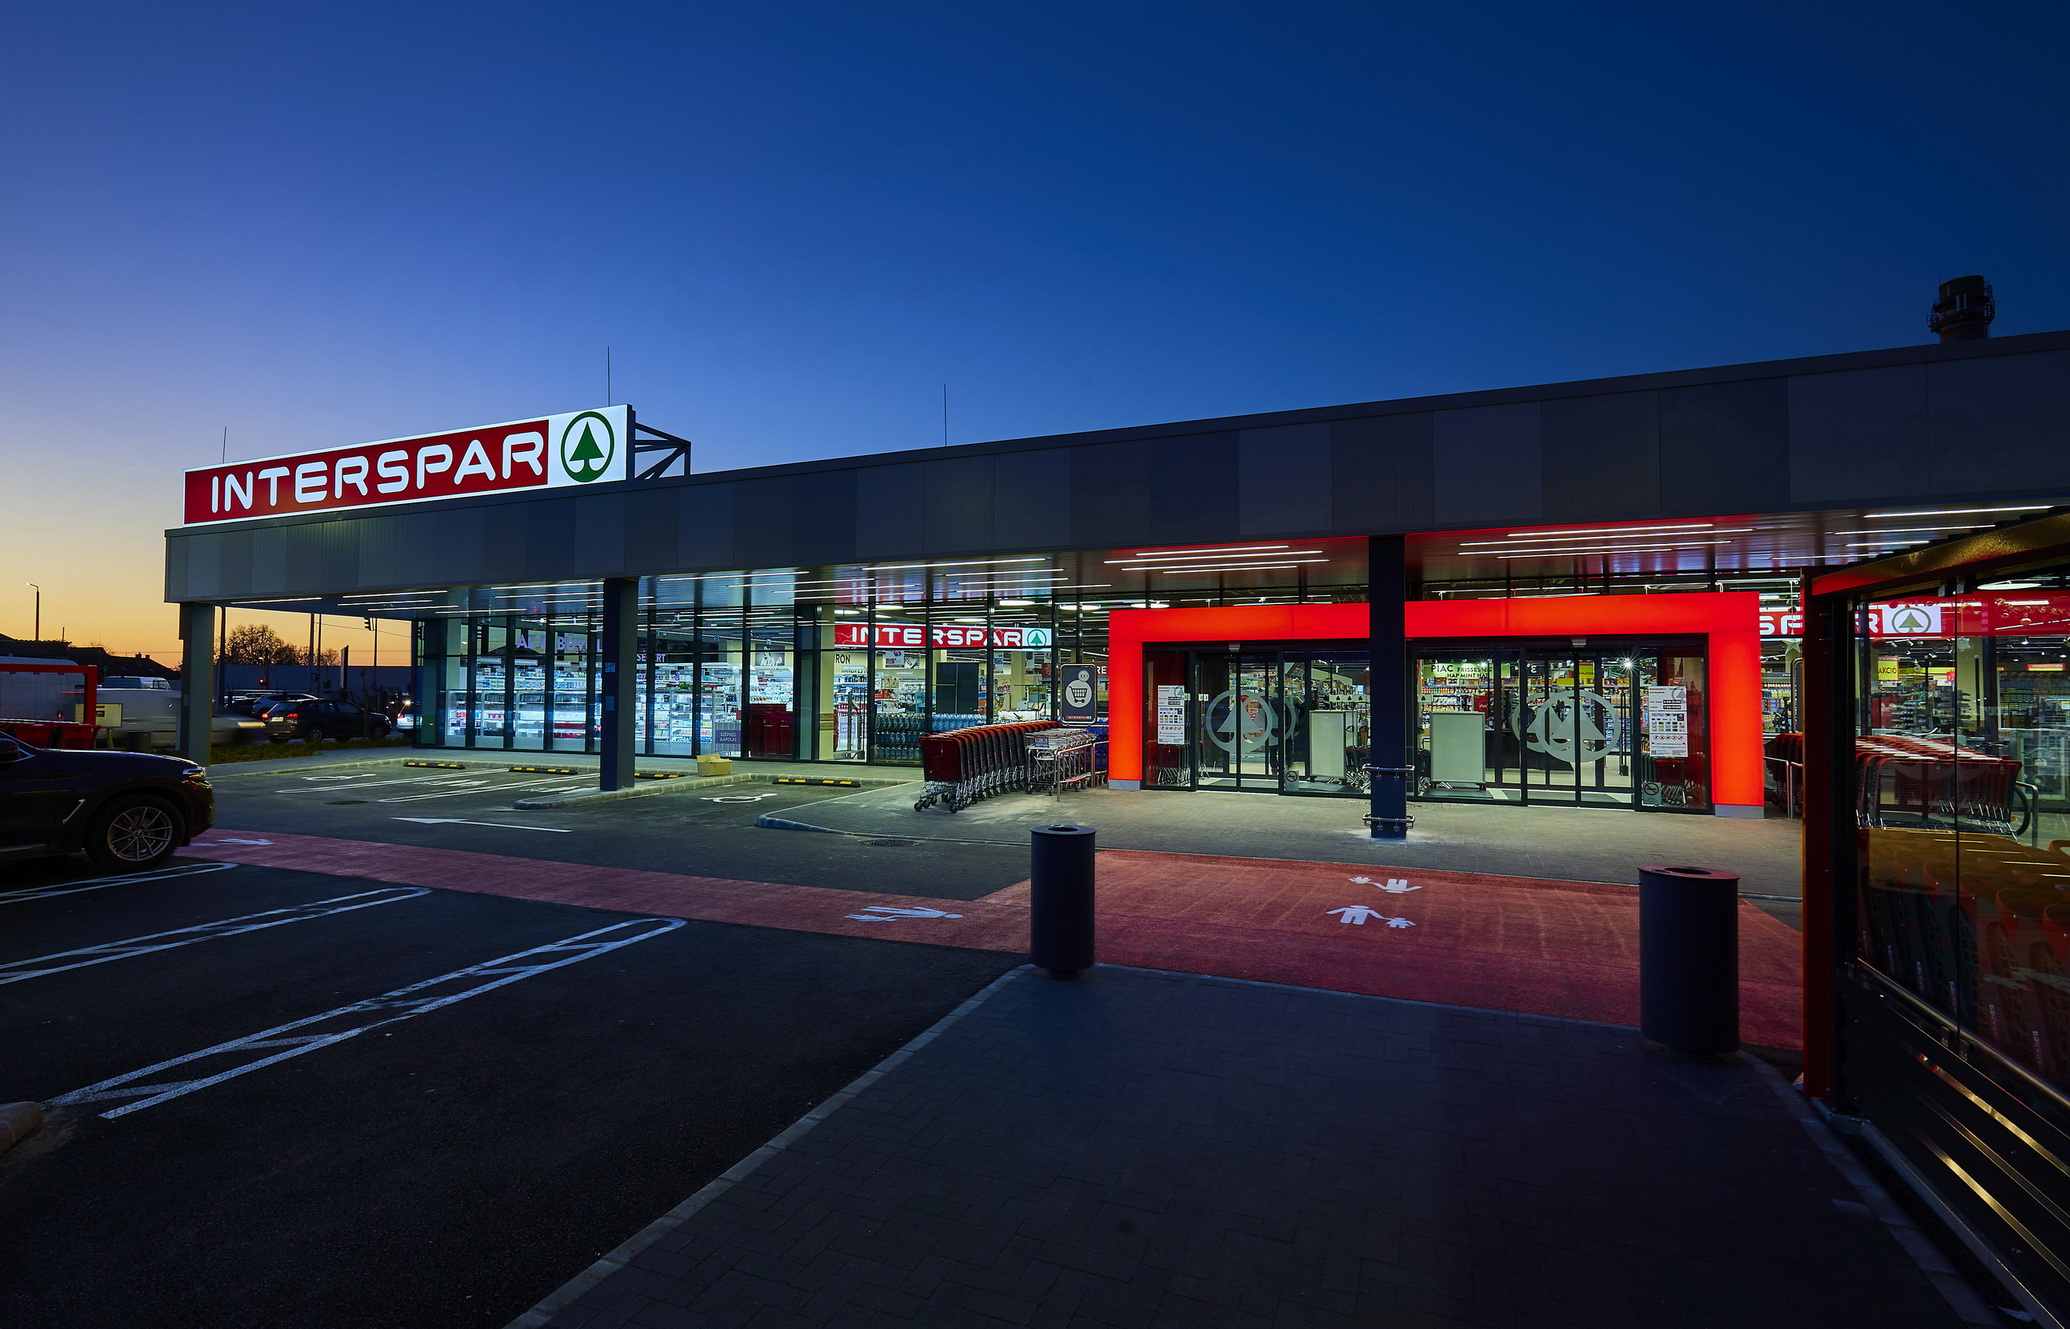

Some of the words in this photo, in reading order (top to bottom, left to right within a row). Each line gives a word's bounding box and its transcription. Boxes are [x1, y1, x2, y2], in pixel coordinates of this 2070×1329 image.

[211, 431, 545, 514] INTERSPAR
[851, 626, 1019, 647] INTERSPAR
[1431, 664, 1454, 673] PIAC
